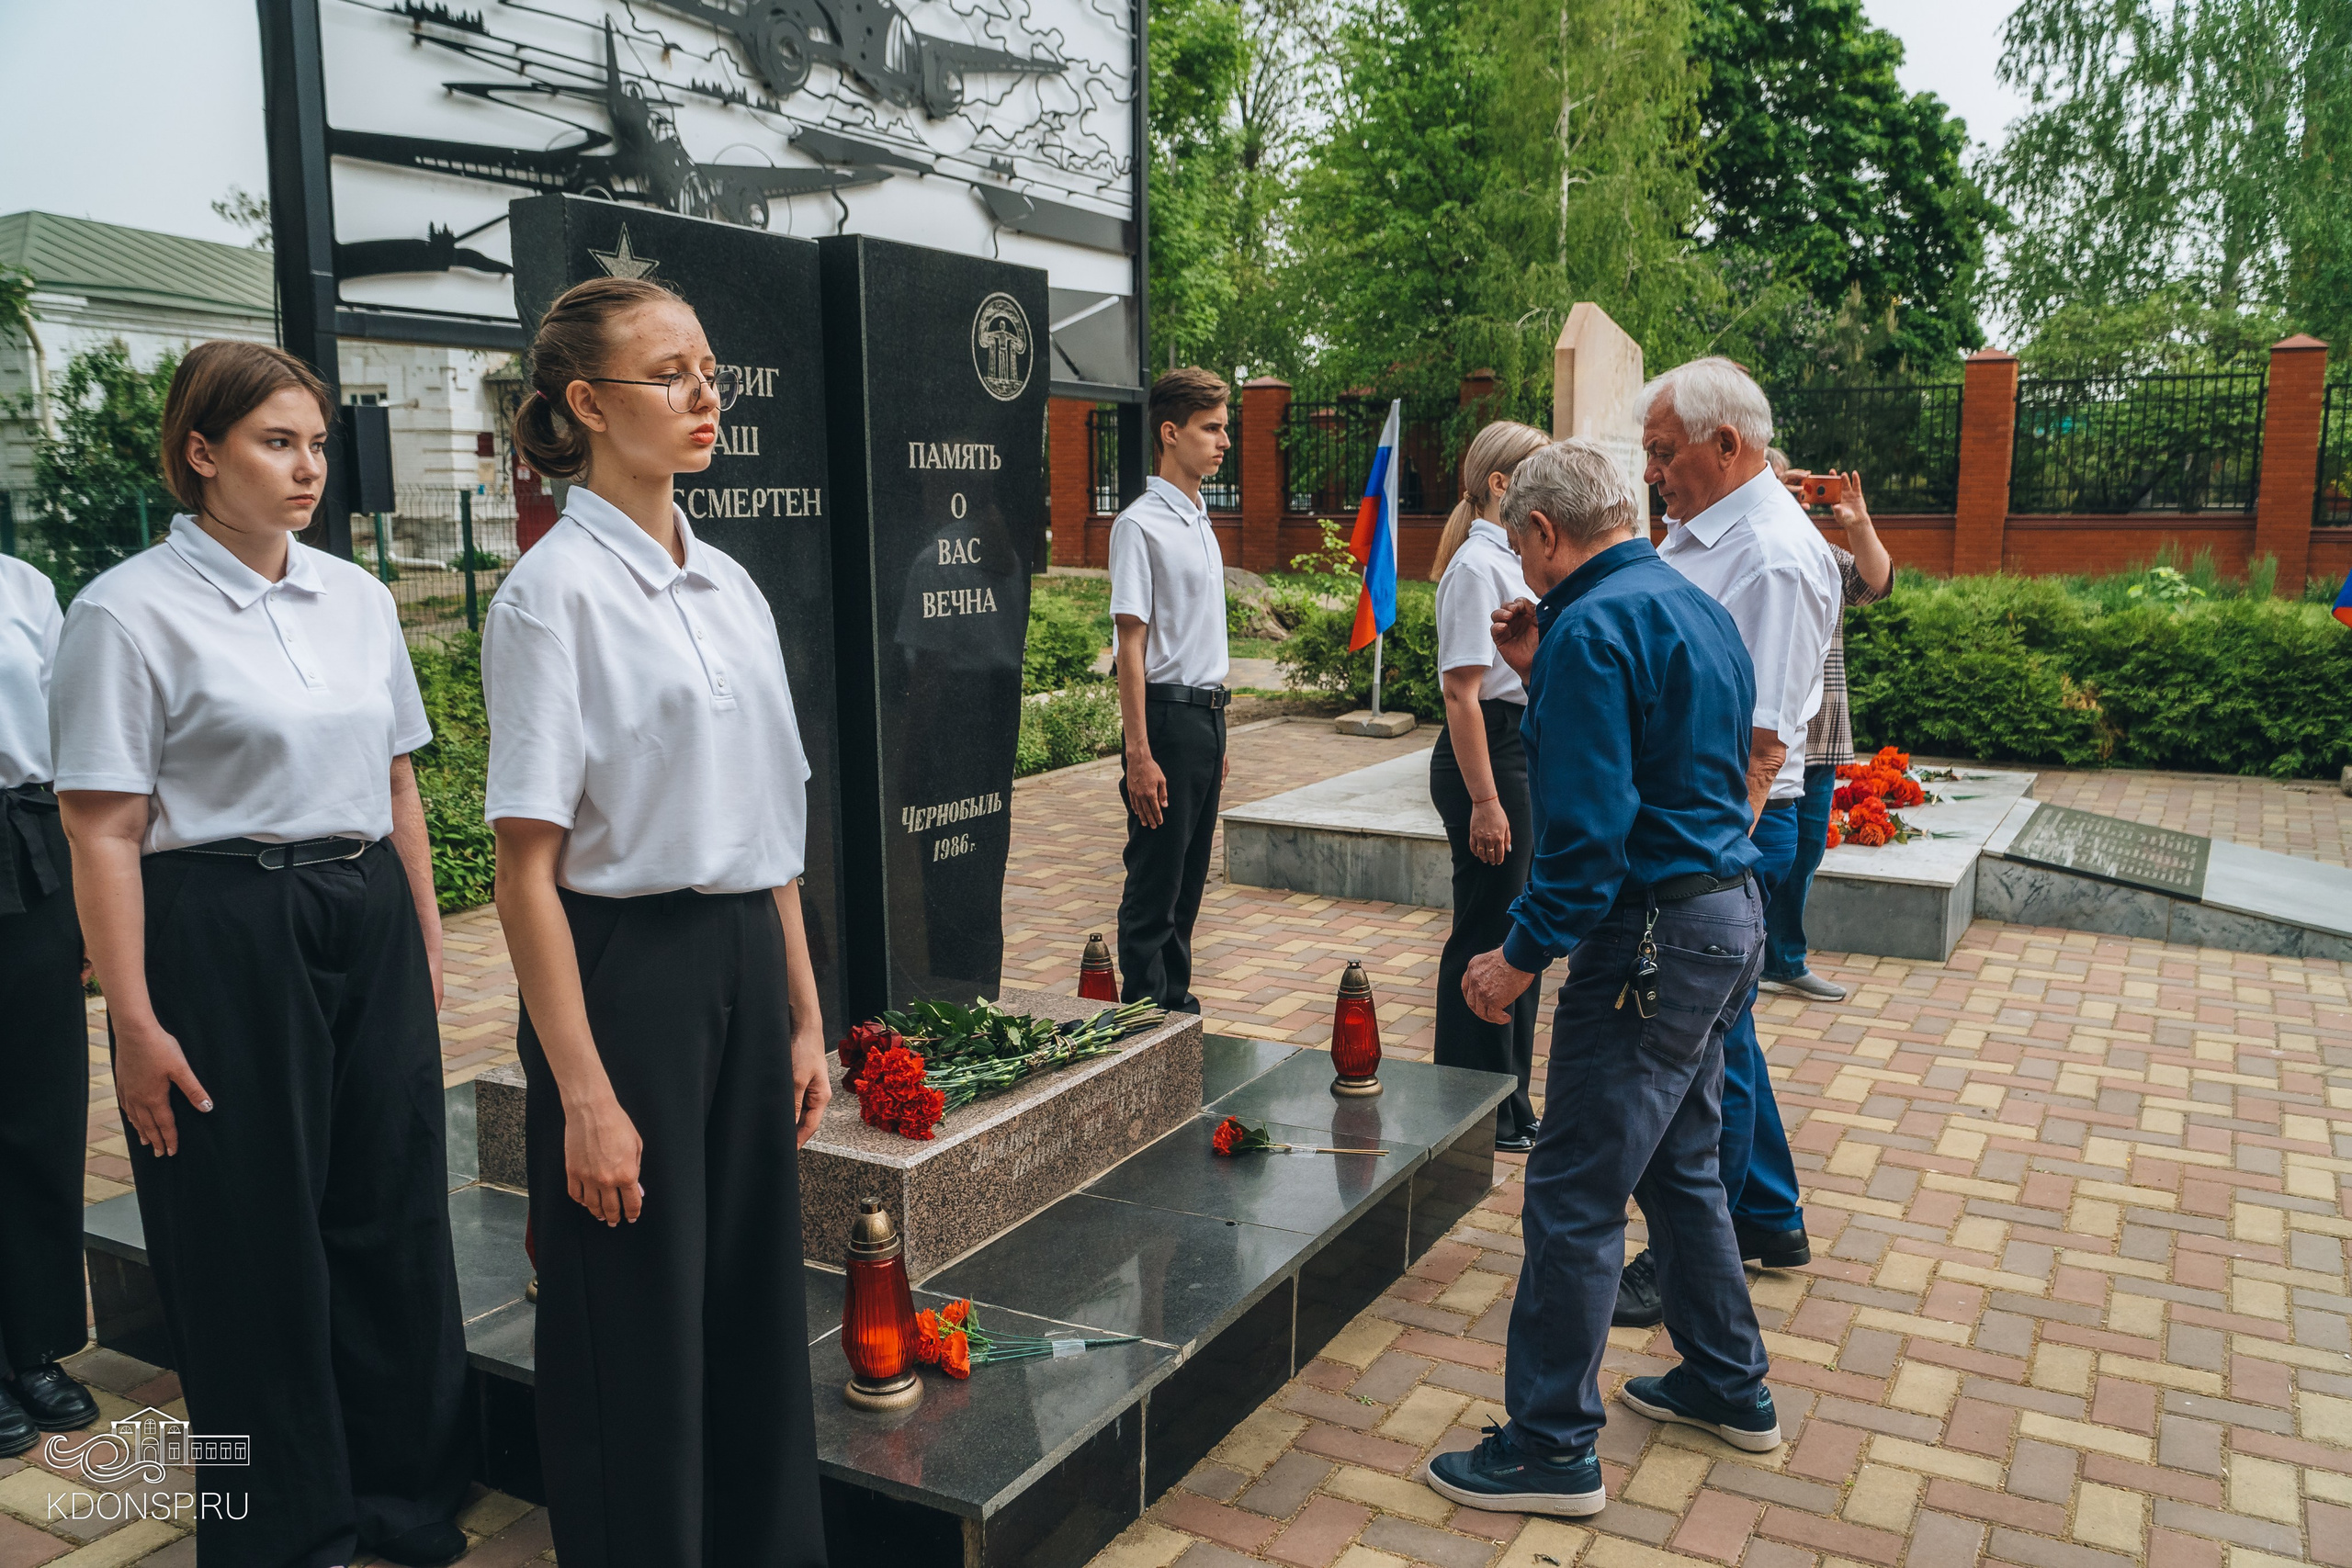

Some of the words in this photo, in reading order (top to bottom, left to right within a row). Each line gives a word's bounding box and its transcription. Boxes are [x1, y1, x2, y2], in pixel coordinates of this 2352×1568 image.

[715, 364, 779, 398] ВИГ
[711, 425, 760, 457] АШ
[908, 441, 1001, 470] ПАМЯТЬ
[673, 487, 822, 520] СМЕРТЕН
[950, 492, 967, 520] О
[937, 537, 981, 566] ВАС
[922, 587, 998, 619] ВЕЧНА
[901, 792, 1002, 833] ЧЕРНОБЫЛЬ
